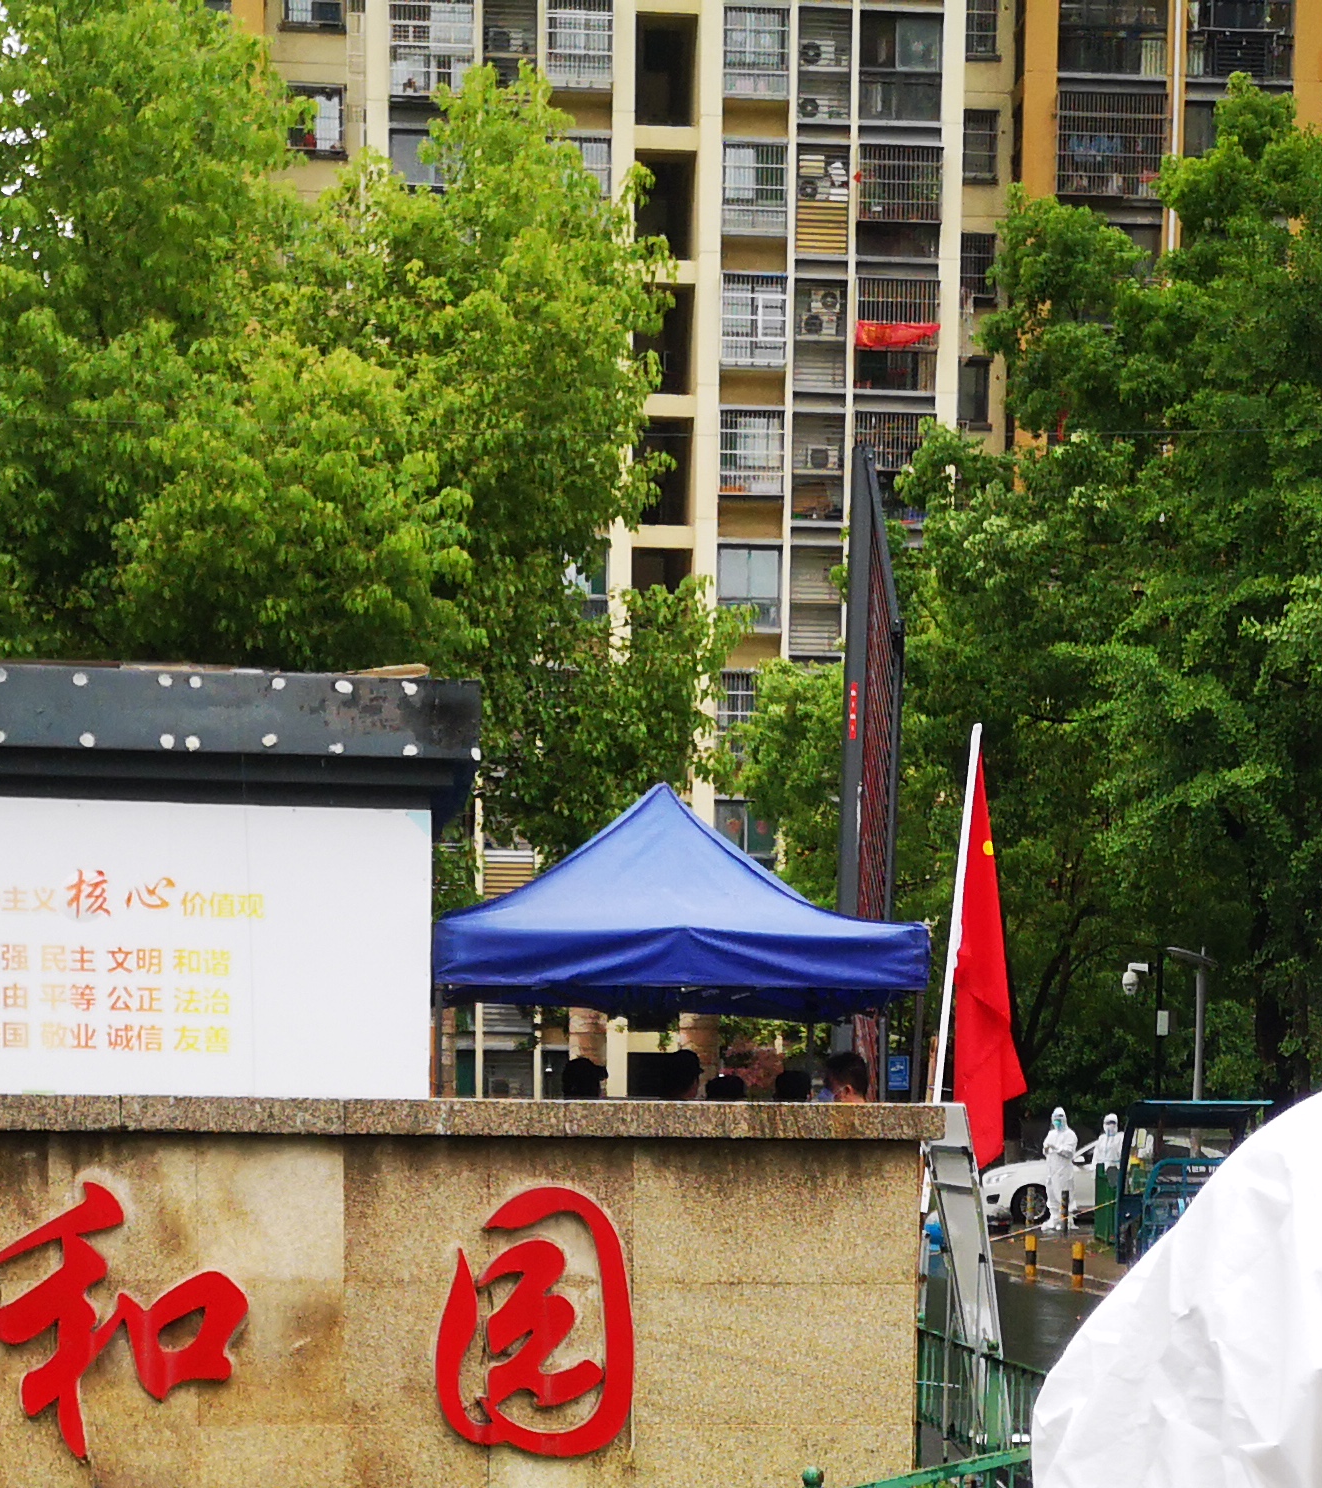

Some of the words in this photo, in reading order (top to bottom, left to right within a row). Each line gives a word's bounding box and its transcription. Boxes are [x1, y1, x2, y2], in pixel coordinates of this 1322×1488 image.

[40, 945, 96, 973] 民主
[107, 946, 163, 974] 文明
[173, 948, 231, 976] 和谐
[40, 983, 96, 1012] 平等
[107, 985, 163, 1013] 公正
[173, 986, 230, 1015] 法治
[40, 1022, 96, 1051] 敬业
[107, 1023, 163, 1052] 诚信
[173, 1025, 230, 1053] 友善
